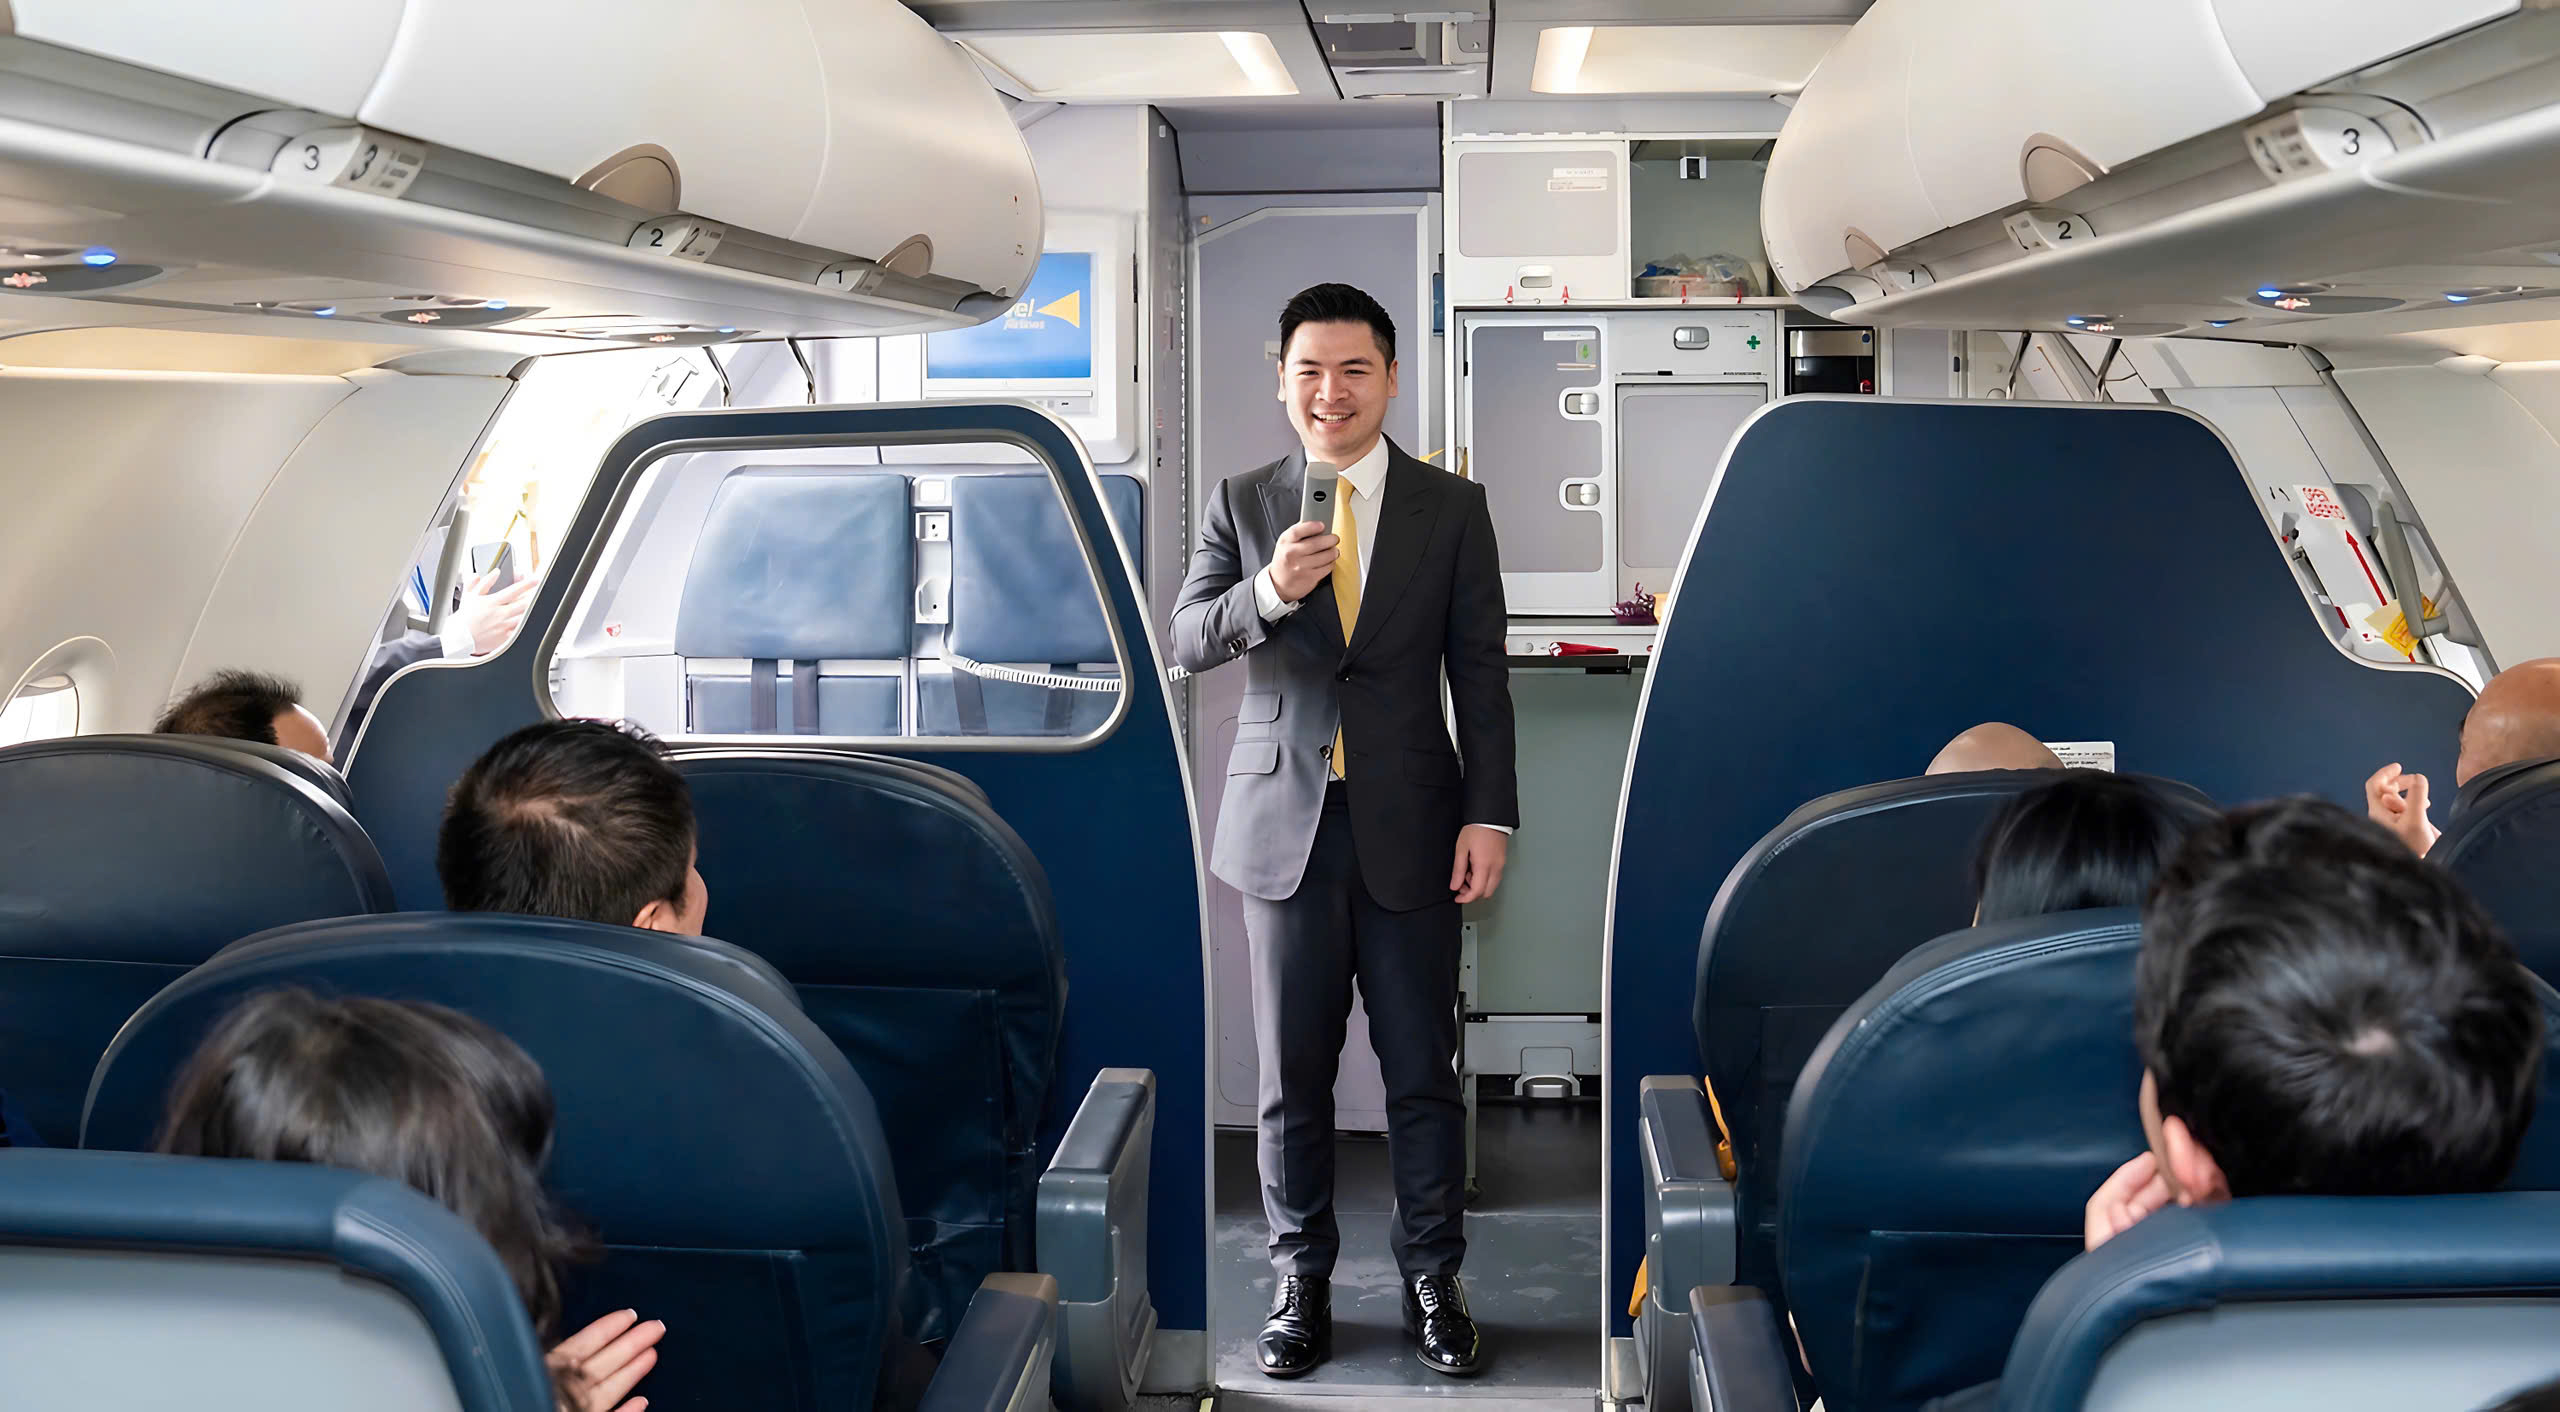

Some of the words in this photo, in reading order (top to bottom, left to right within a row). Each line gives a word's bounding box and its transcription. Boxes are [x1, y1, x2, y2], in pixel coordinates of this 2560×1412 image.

[2343, 128, 2360, 155] 3
[304, 145, 320, 170] 3
[650, 228, 664, 247] 2
[2058, 220, 2072, 239] 2
[836, 270, 843, 284] 1
[1908, 269, 1915, 284] 1
